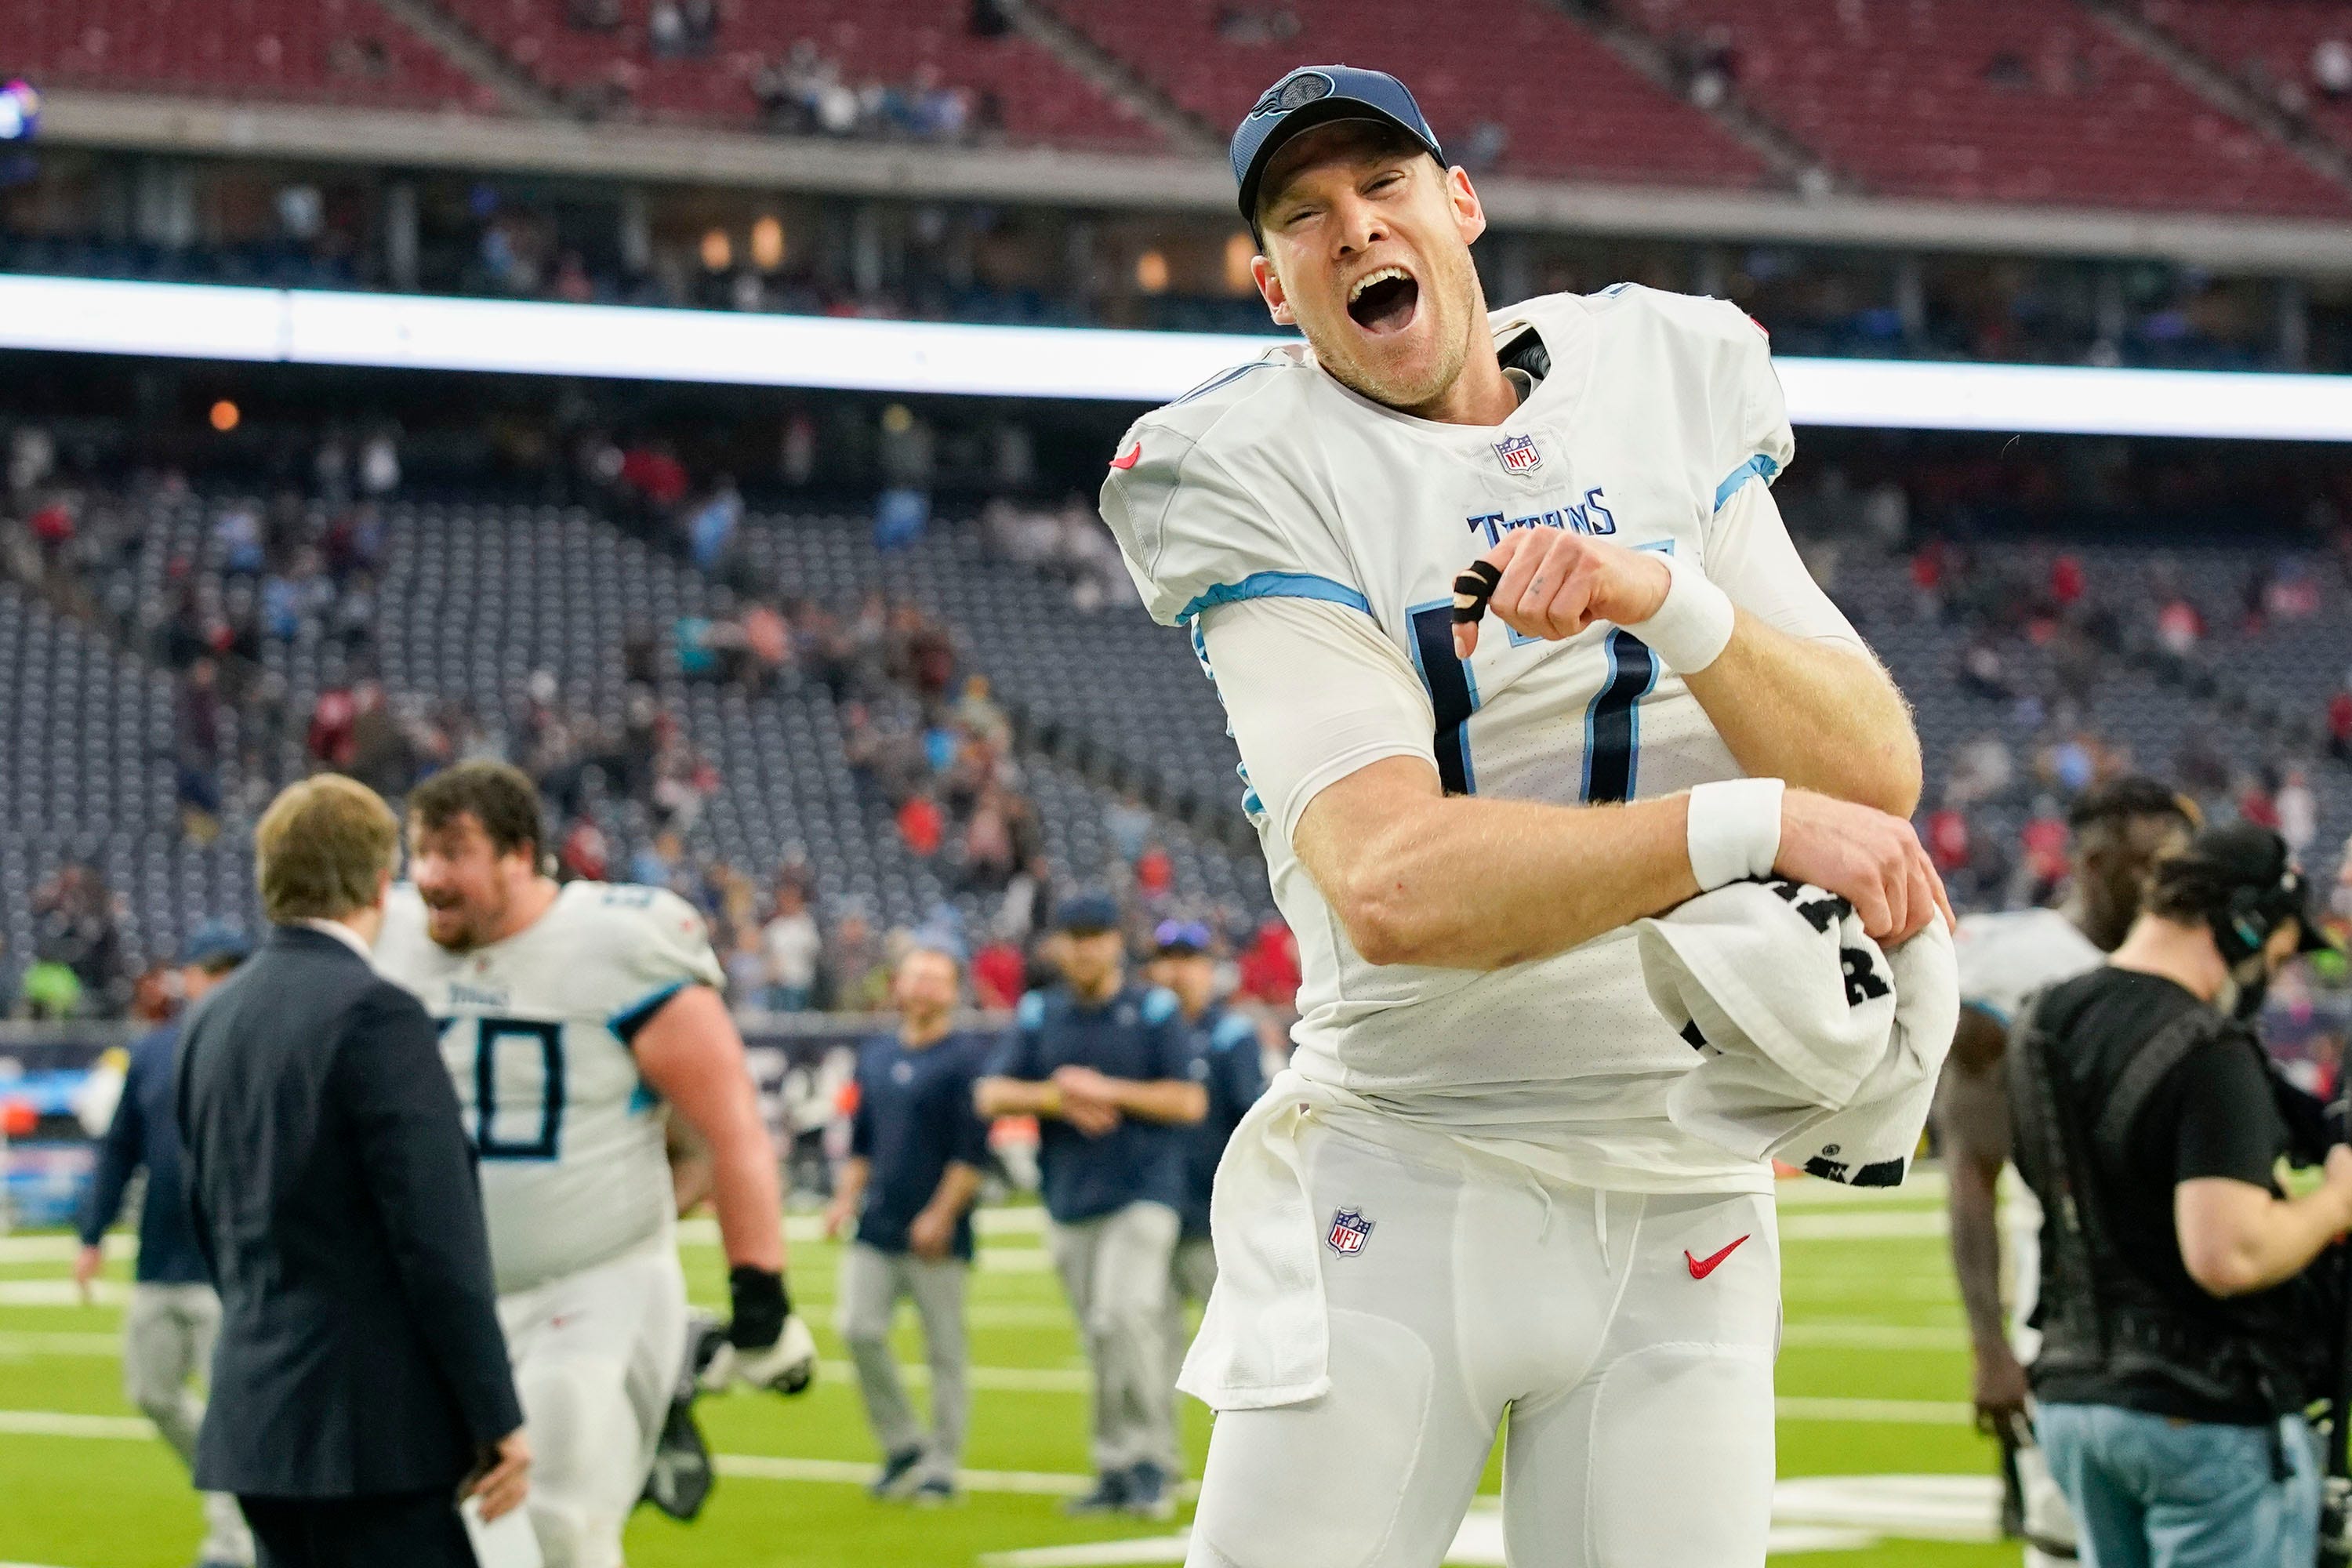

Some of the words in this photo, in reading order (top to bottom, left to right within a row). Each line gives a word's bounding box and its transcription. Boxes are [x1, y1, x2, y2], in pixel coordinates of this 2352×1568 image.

[1505, 448, 1537, 468] NFL
[435, 1016, 566, 1162] 0
[1331, 1225, 1359, 1250] NFL
